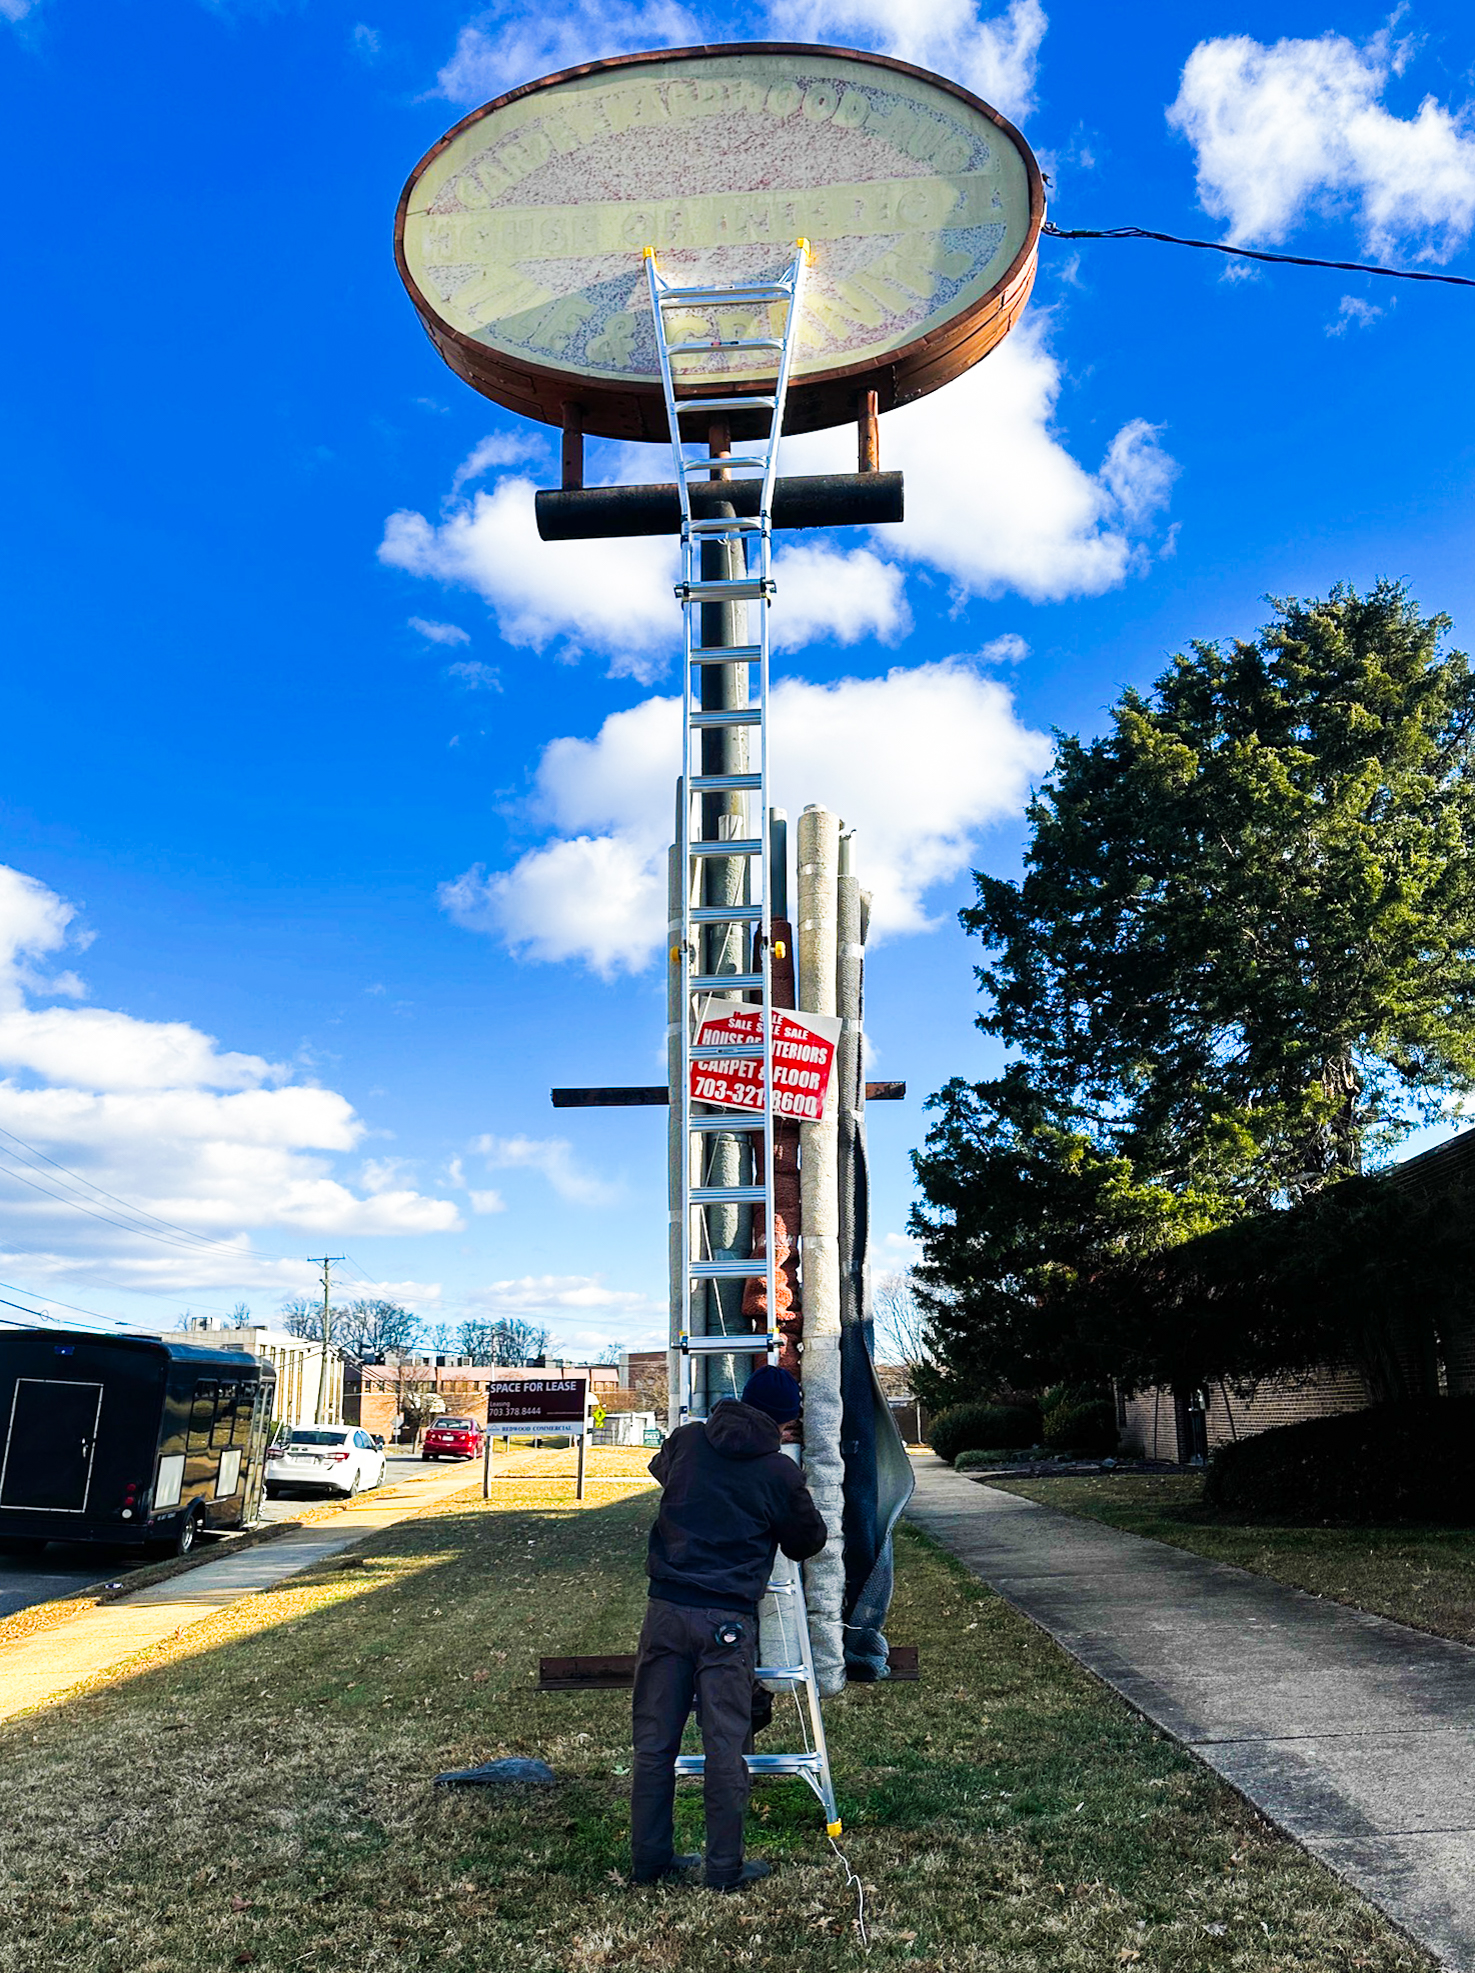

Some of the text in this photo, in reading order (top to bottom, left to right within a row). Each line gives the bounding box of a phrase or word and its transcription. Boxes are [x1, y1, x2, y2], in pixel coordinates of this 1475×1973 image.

[422, 213, 599, 260] HOUSE
[621, 208, 690, 248] OF
[585, 312, 637, 367] &
[728, 1018, 752, 1031] SALE
[783, 1026, 810, 1040] SALE
[758, 1012, 784, 1025] SLE
[773, 1066, 821, 1090] FLOOR
[490, 1381, 577, 1393] SPACE FOR LEASE
[489, 1407, 541, 1416] 703.378.8444
